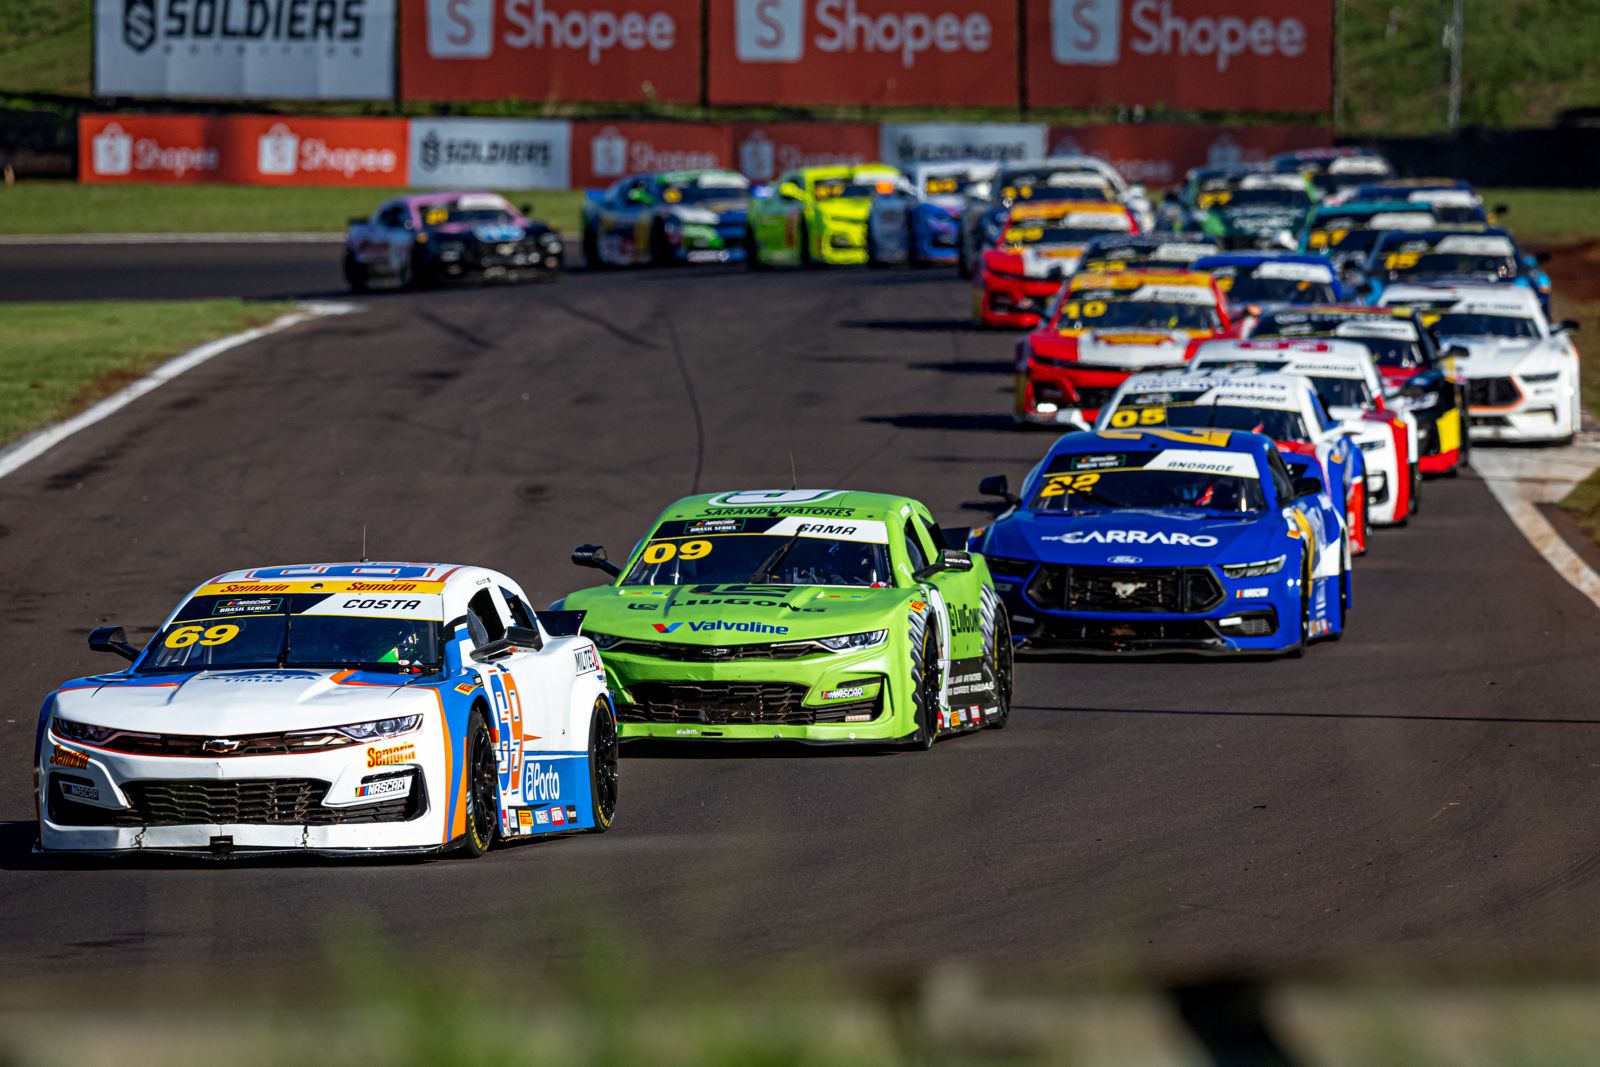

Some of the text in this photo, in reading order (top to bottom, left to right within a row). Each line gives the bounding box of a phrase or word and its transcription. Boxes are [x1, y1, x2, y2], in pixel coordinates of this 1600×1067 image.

[503, 0, 677, 62] Shopee
[815, 2, 992, 66] Shopee
[1129, 4, 1307, 70] Shopee
[135, 139, 219, 176] Shopee
[301, 139, 397, 177] Shopee
[1061, 300, 1108, 319] 10
[1111, 406, 1167, 429] 05
[1167, 461, 1234, 472] ANDRADE
[798, 523, 857, 535] GAMA
[642, 539, 713, 565] 09
[220, 584, 290, 593] Semorin
[346, 582, 417, 591] Semorin
[342, 600, 422, 610] COSTA
[164, 623, 240, 649] 69
[688, 619, 790, 636] Valvoline
[367, 742, 417, 768] Semorin
[367, 779, 406, 797] NASCAR
[534, 762, 561, 801] Porto
